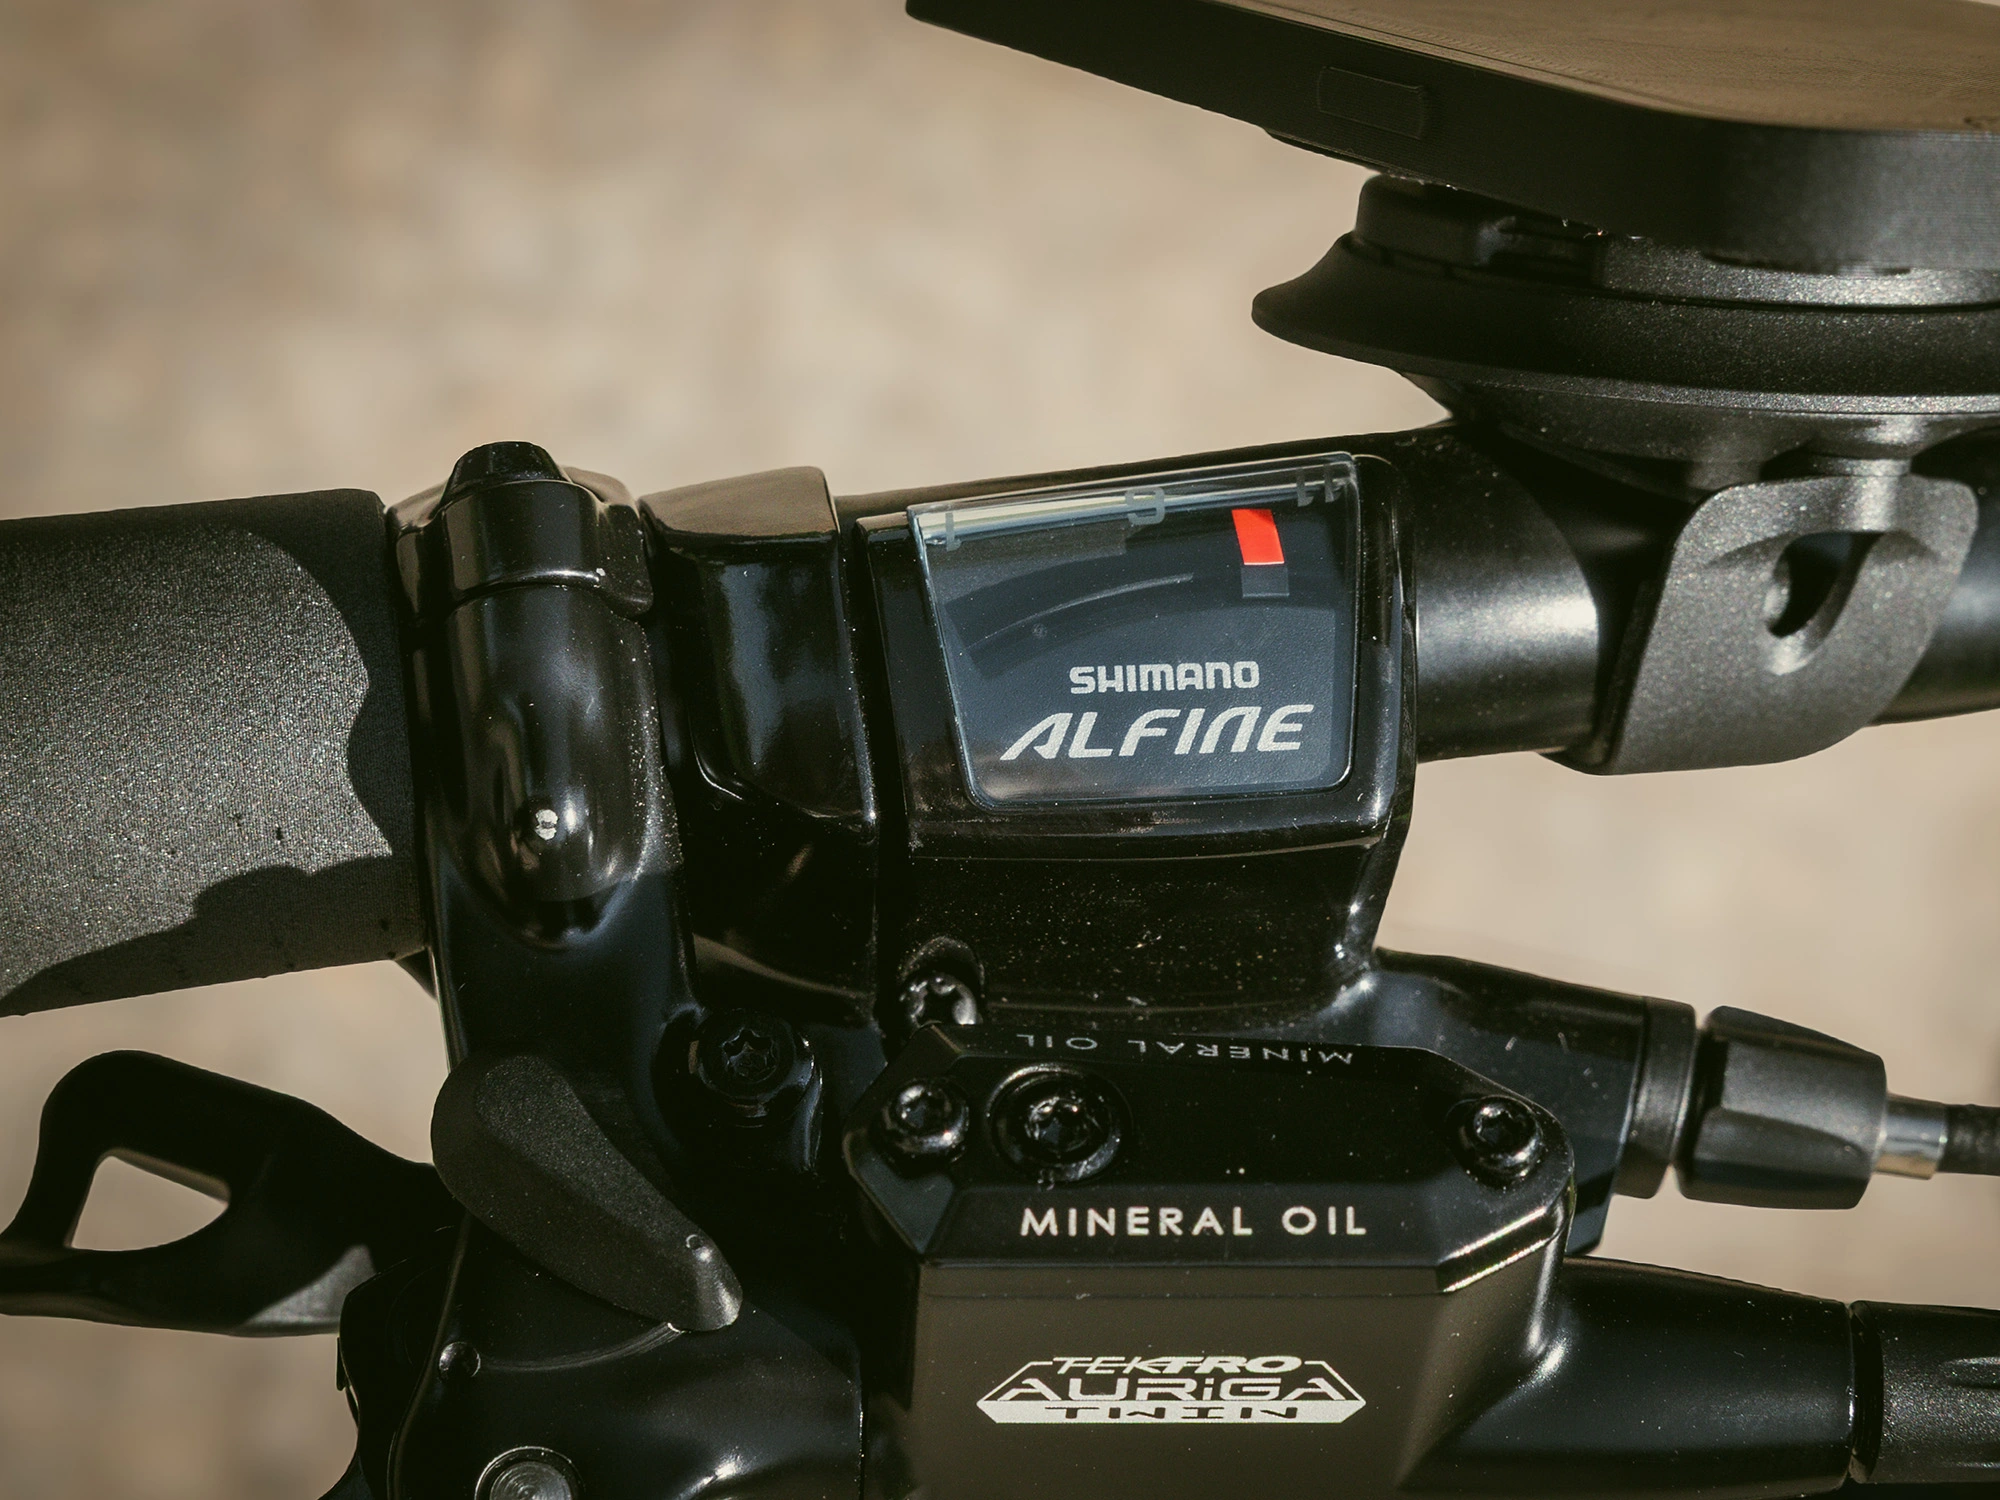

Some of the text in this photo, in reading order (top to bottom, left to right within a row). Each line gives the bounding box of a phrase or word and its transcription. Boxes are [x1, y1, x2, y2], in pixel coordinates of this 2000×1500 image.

[1069, 660, 1260, 694] SHIMANO
[999, 704, 1315, 761] ALFINE
[1016, 1033, 1353, 1065] MINERAL OIL
[1020, 1206, 1367, 1237] MINERAL OIL
[1053, 1356, 1302, 1375] TEKTRO
[1045, 1406, 1298, 1420] TWIN
